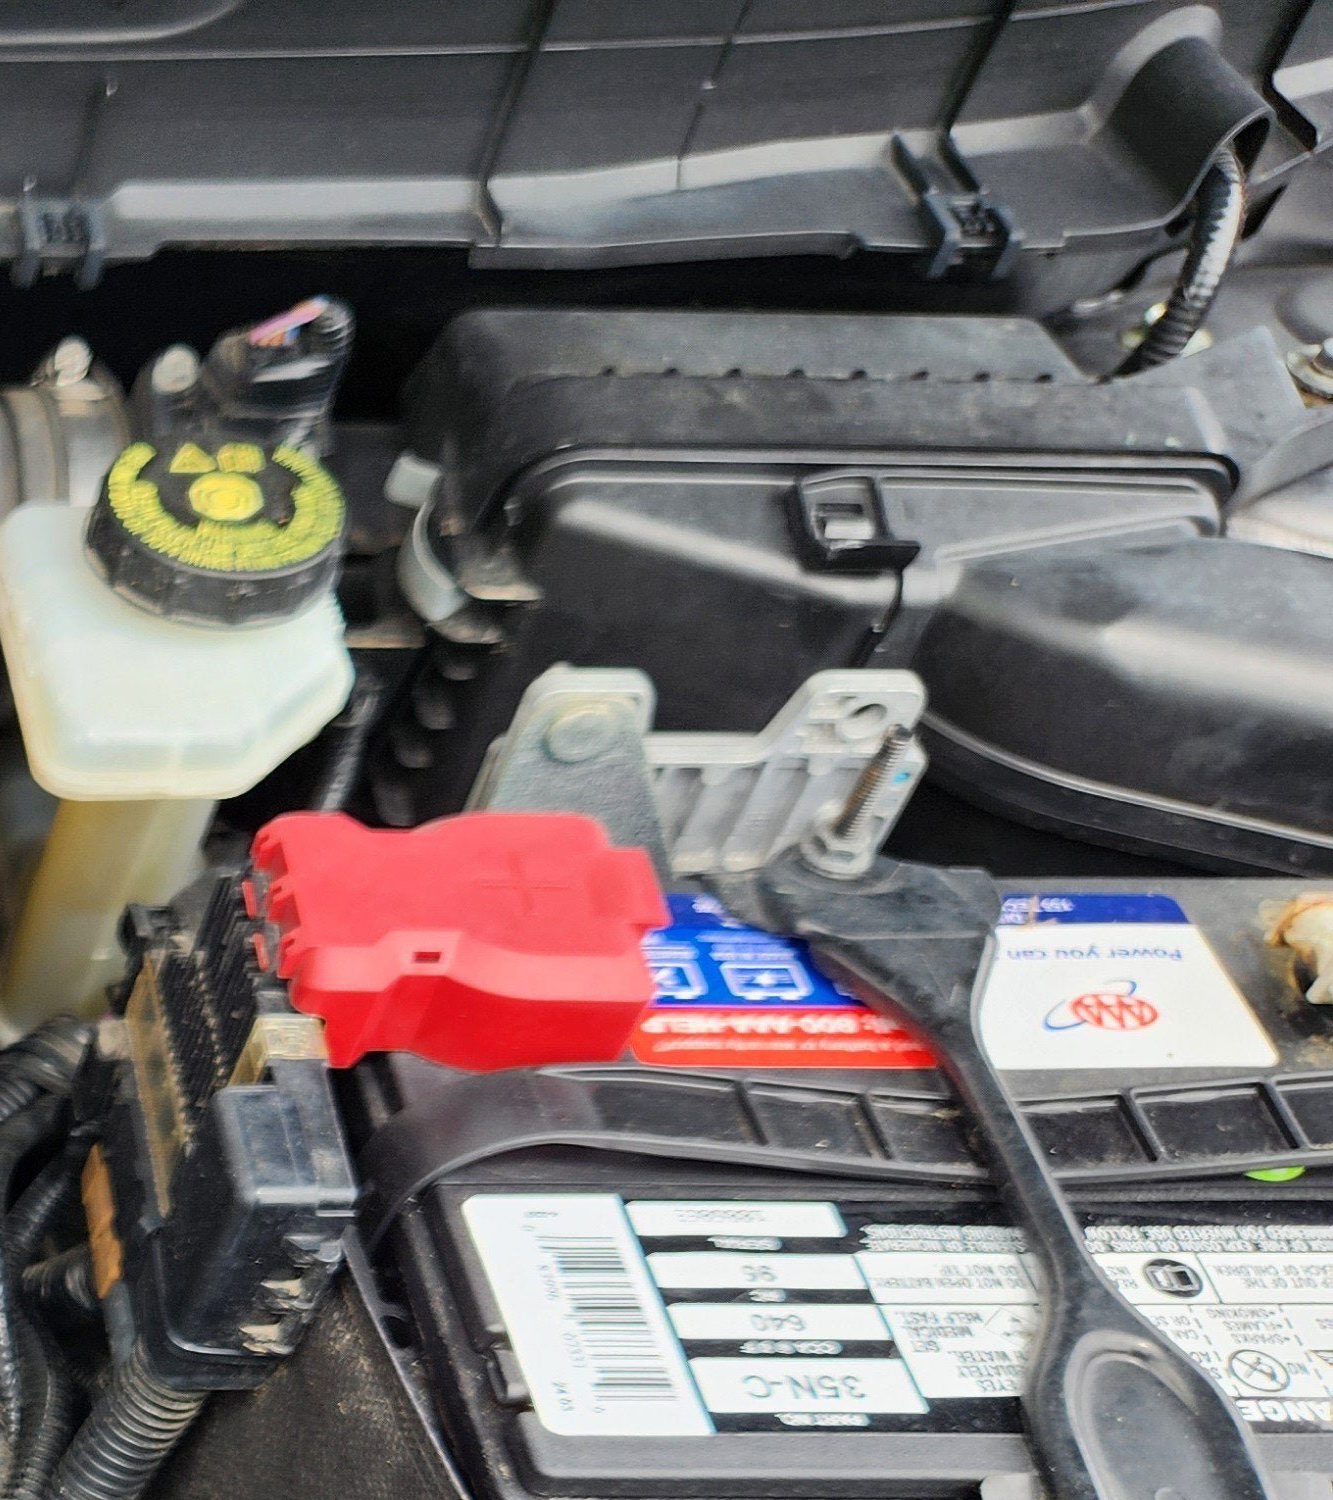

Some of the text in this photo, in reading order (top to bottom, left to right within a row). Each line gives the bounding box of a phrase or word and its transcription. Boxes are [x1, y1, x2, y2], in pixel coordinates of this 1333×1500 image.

[1007, 946, 1183, 962] Power you can
[1071, 994, 1158, 1030] AAA
[741, 1265, 777, 1282] 95
[750, 1314, 805, 1331] 640
[742, 1375, 867, 1400] 35N-C
